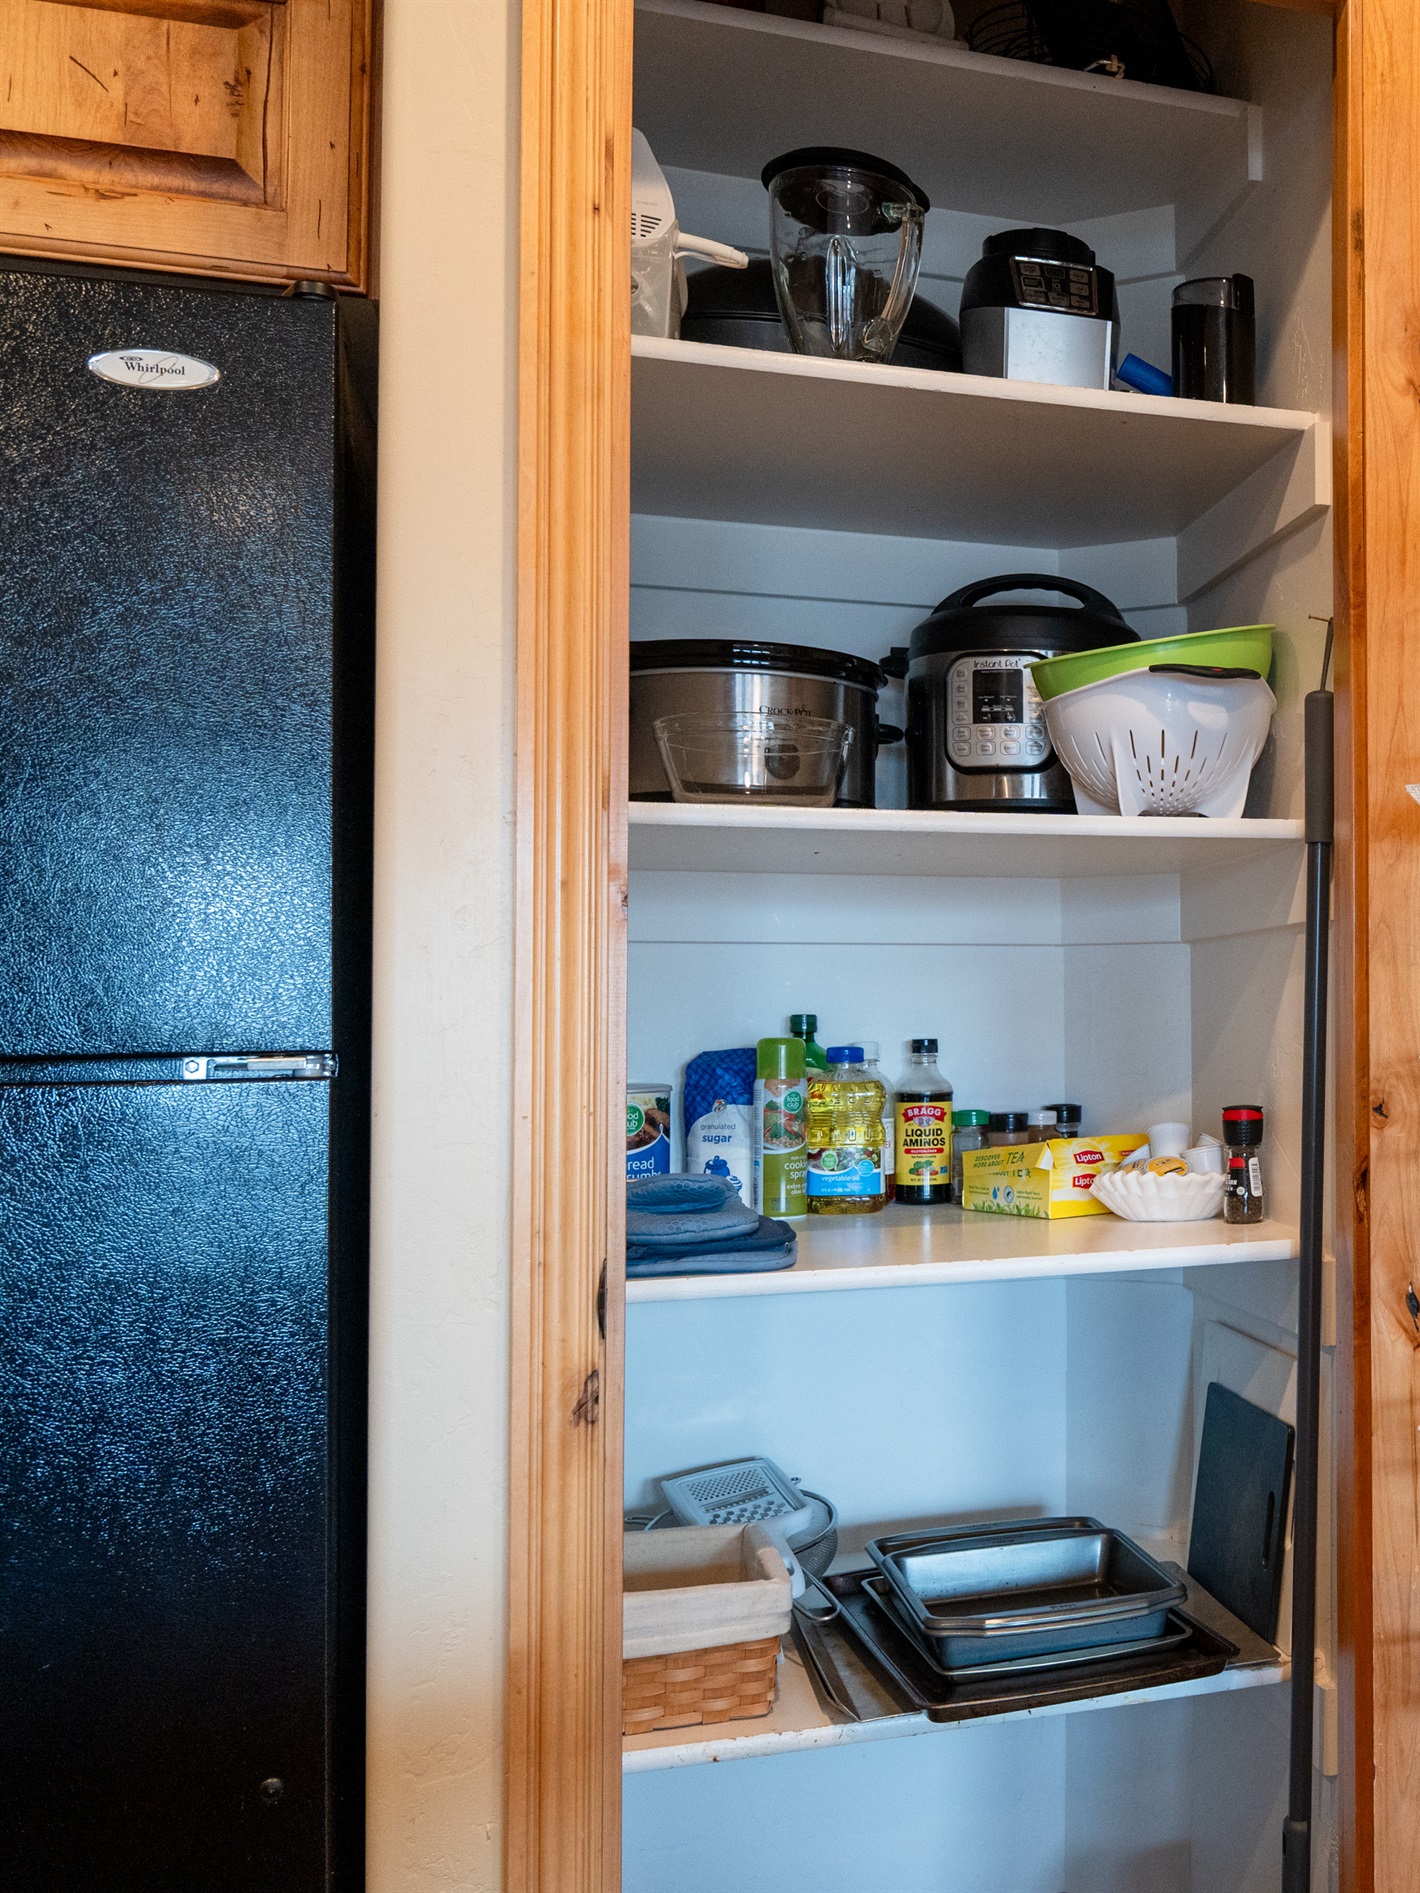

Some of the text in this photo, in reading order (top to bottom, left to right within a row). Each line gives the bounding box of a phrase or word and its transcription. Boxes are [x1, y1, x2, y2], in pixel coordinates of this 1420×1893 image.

[124, 362, 185, 376] Whirlpool
[974, 659, 1019, 668] Instant Pot
[627, 1111, 639, 1120] od
[907, 1107, 941, 1116] BRAGG
[627, 1119, 638, 1128] ub
[700, 1123, 736, 1131] granulated
[905, 1128, 943, 1138] LIQUID
[702, 1134, 732, 1144] sugar
[902, 1138, 946, 1147] AMINOS
[975, 1154, 1001, 1162] DISCOVER
[988, 1160, 1004, 1168] ABOUT
[1006, 1151, 1025, 1165] TEA
[1076, 1154, 1102, 1163] Lipton
[628, 1157, 654, 1170] read
[784, 1162, 807, 1170] cooki
[790, 1171, 806, 1180] spra
[1074, 1176, 1094, 1186] Lipto
